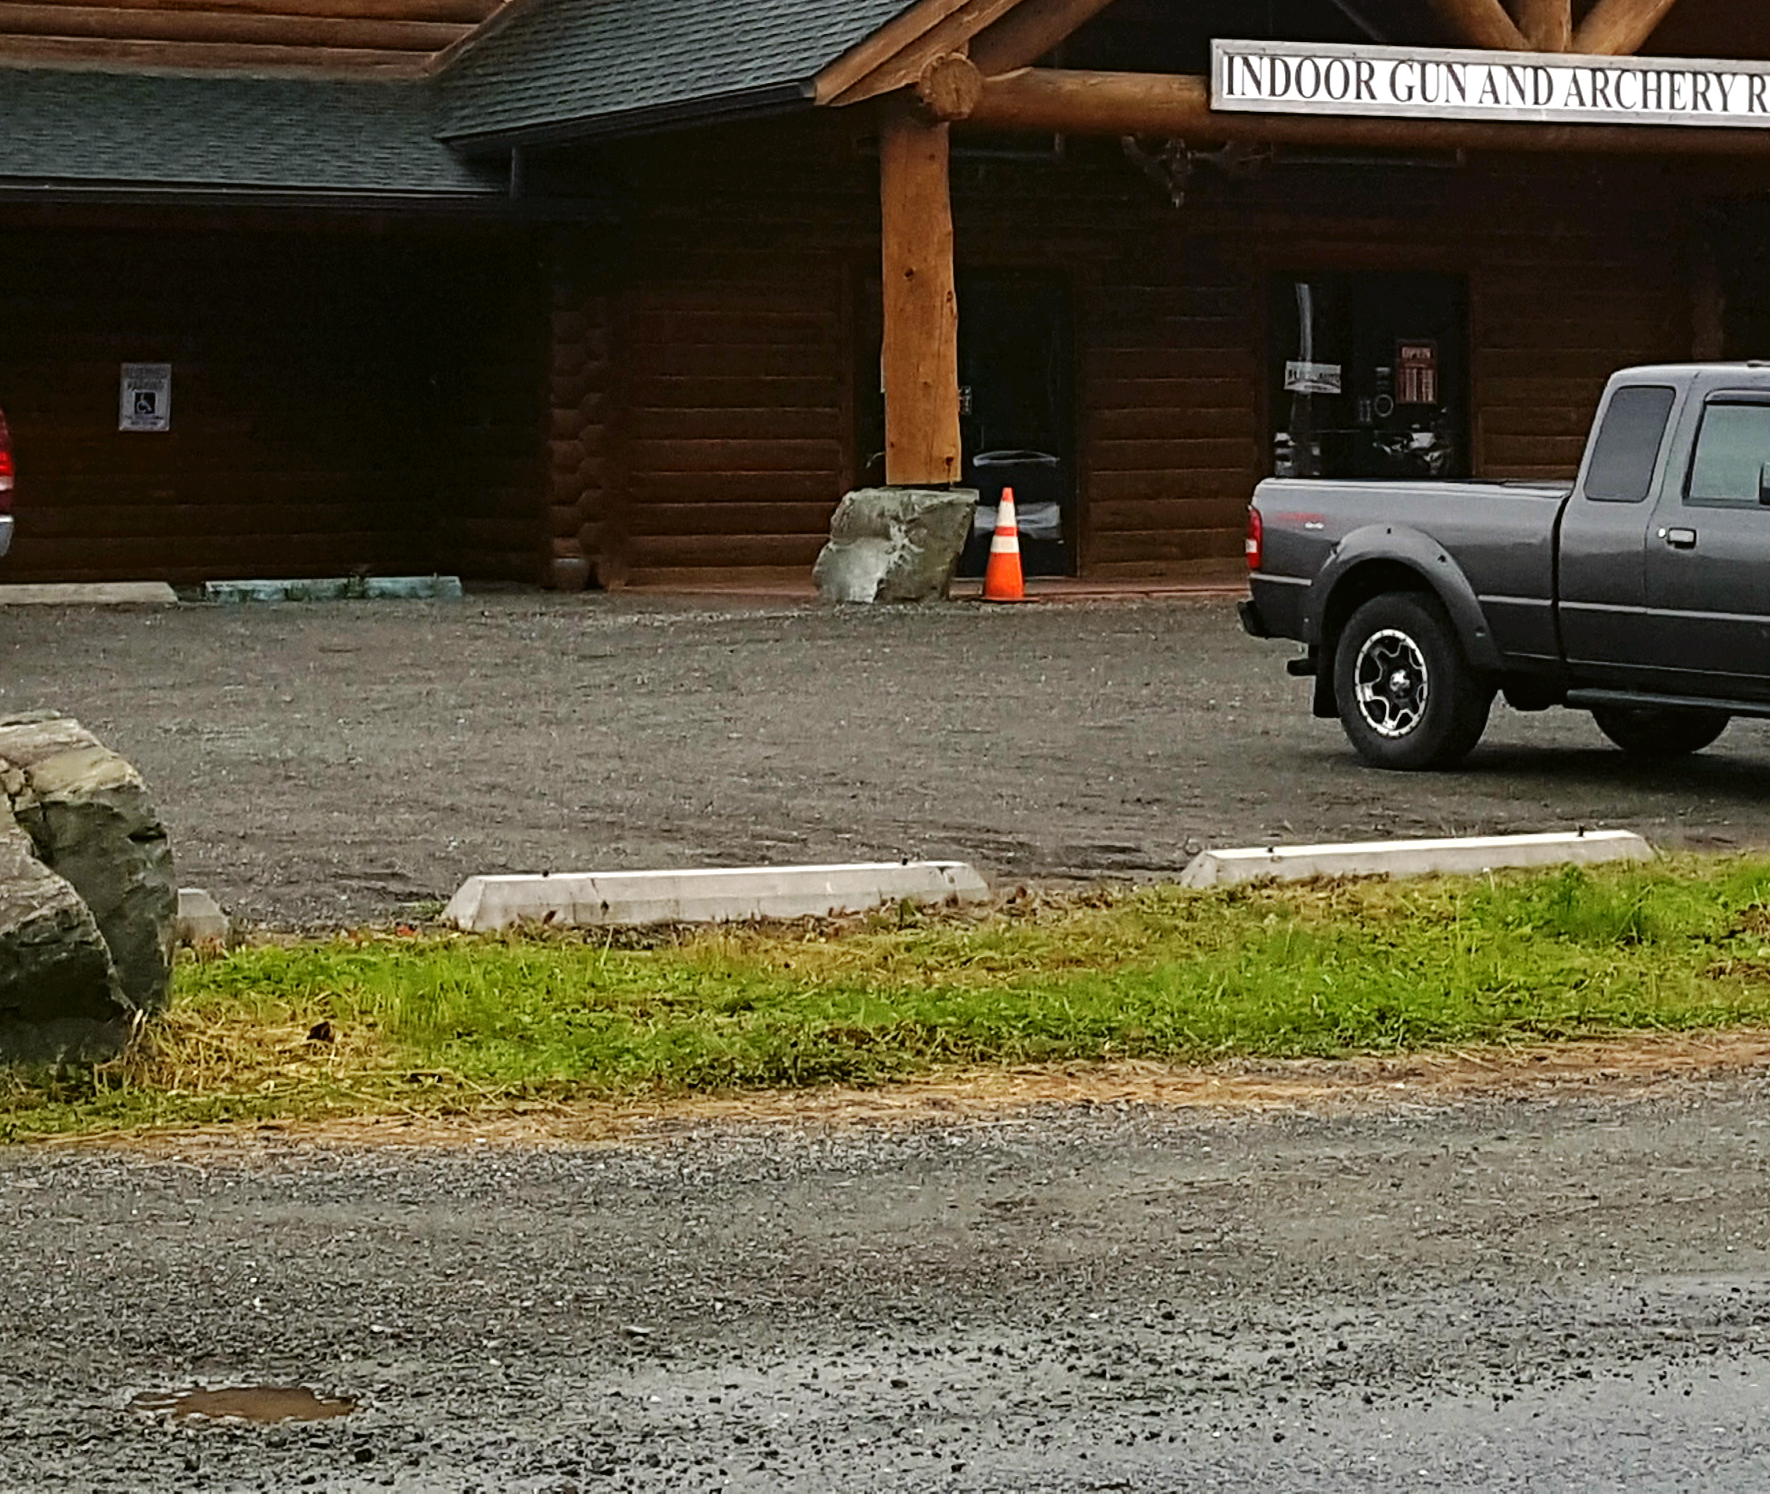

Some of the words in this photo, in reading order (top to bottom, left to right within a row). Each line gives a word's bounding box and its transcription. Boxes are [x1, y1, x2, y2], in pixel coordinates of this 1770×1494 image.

[1225, 54, 1378, 101] INDOOR
[1389, 59, 1467, 104] GUN
[1478, 63, 1554, 106] AND
[1563, 67, 1740, 114] ARCHERY
